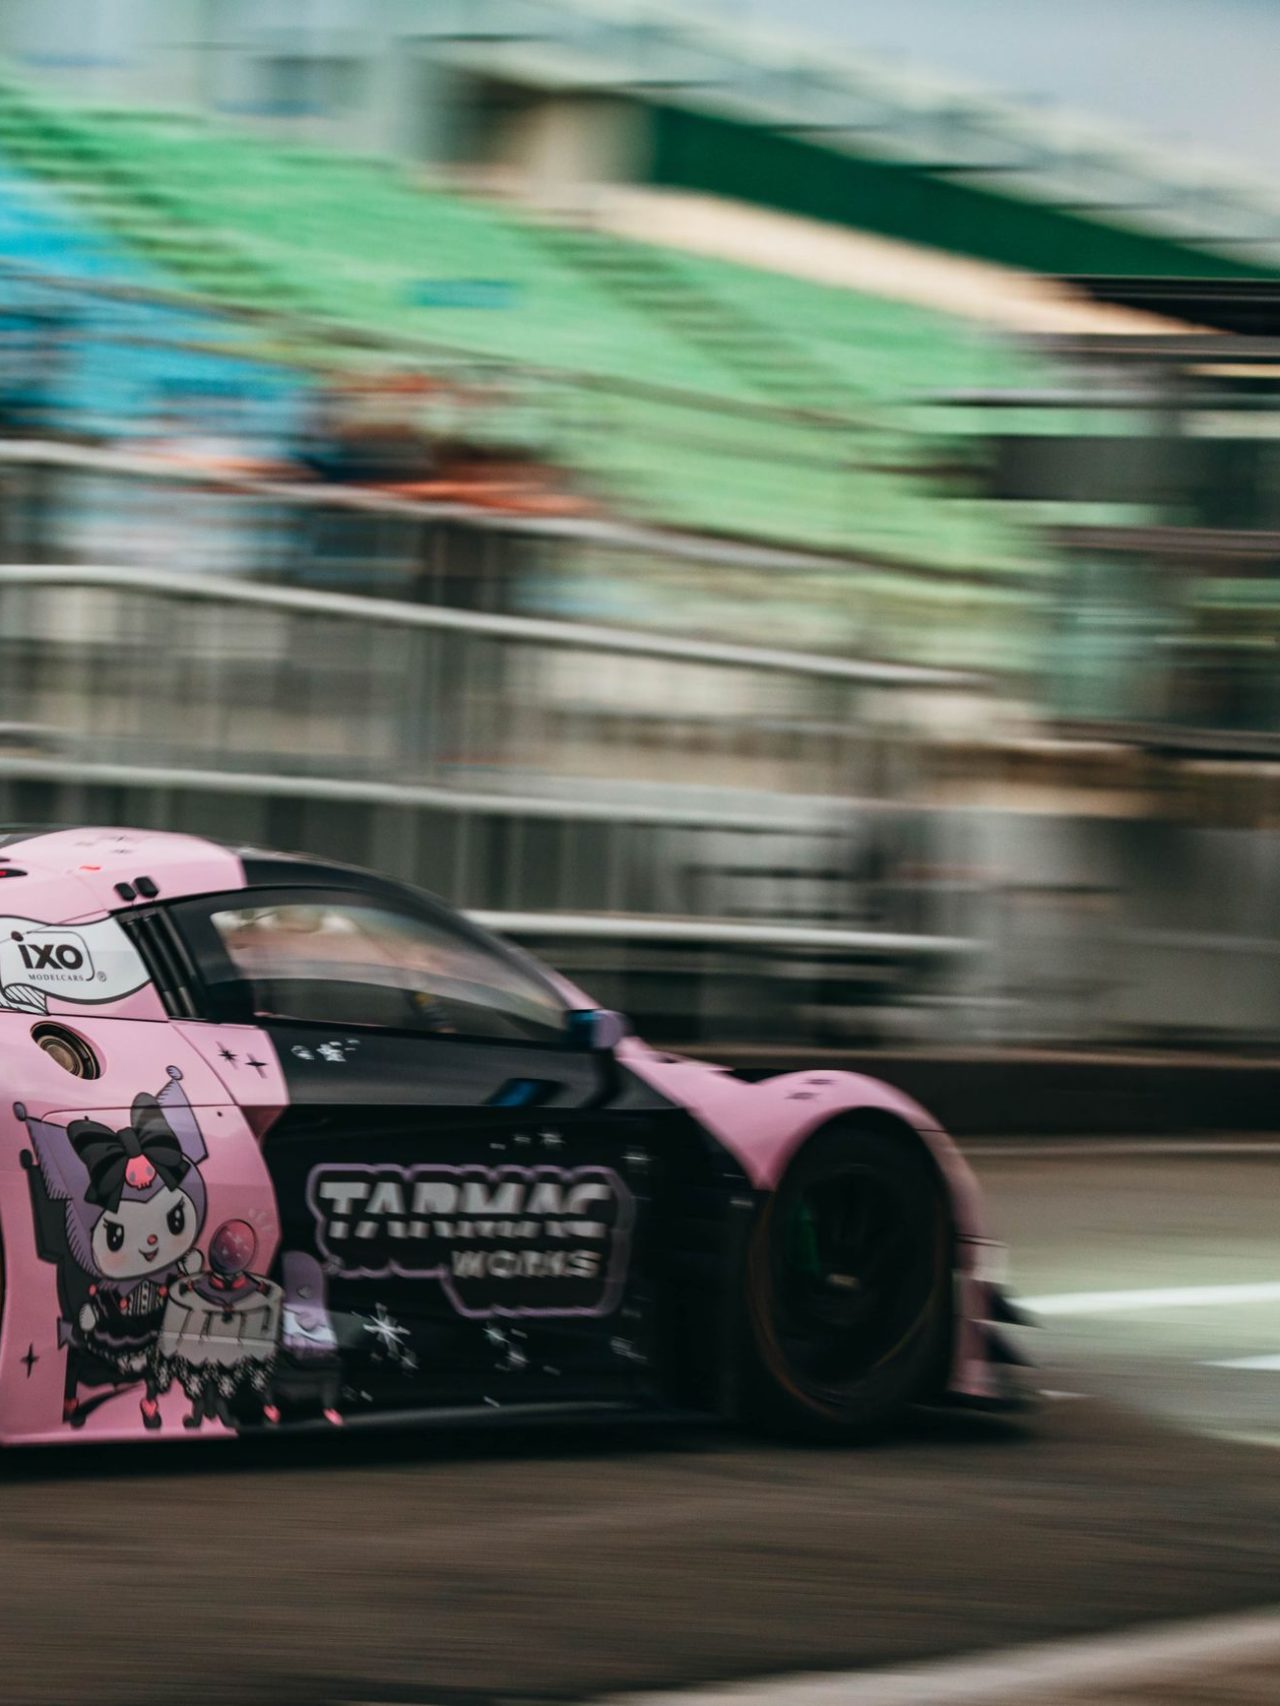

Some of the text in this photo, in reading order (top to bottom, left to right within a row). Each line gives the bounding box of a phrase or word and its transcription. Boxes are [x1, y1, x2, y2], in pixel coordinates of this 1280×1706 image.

[27, 973, 85, 982] MODELCARS
[318, 1181, 612, 1239] TARMAC
[451, 1250, 602, 1278] WORKS
